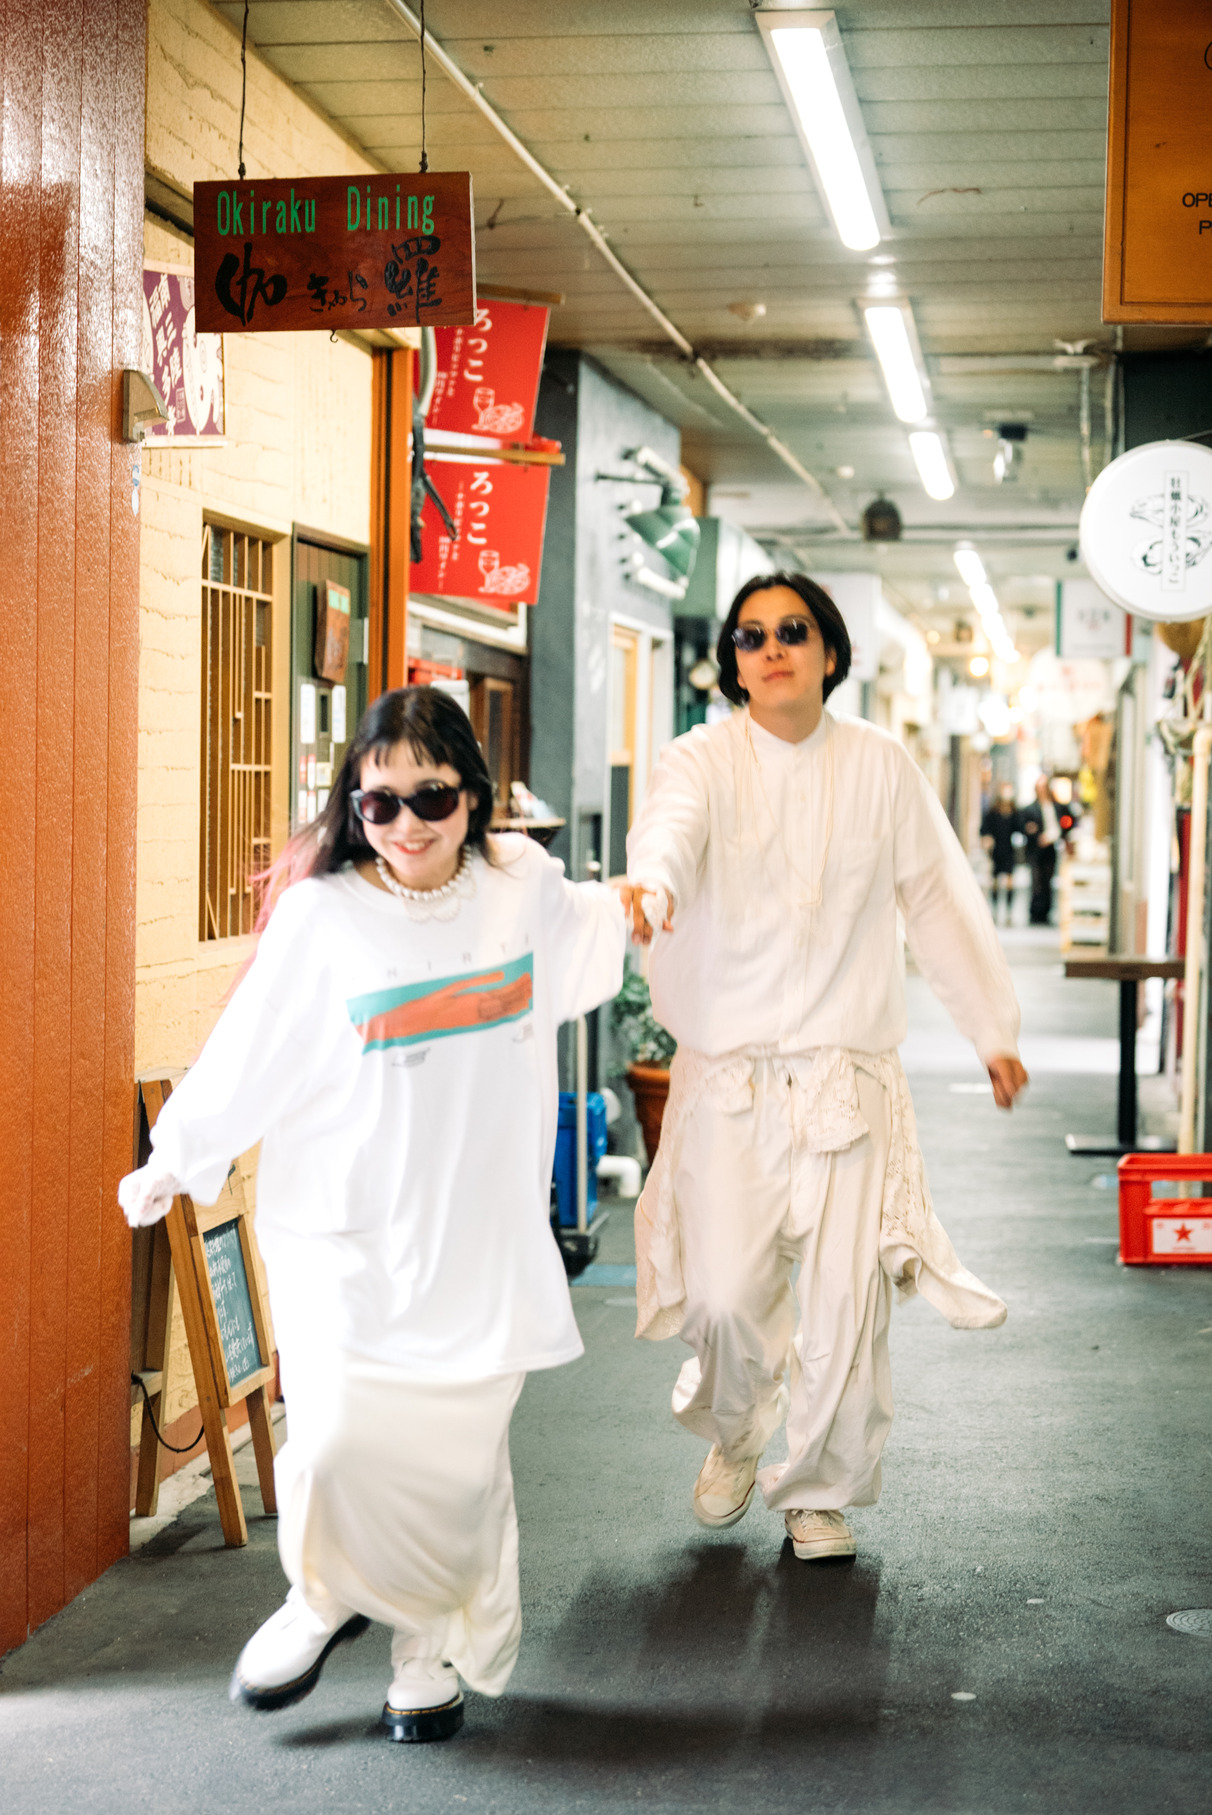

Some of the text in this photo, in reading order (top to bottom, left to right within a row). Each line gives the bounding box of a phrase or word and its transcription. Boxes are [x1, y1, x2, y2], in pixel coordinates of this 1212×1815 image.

[217, 184, 436, 236] Okiraku Dining
[1182, 192, 1212, 208] OP
